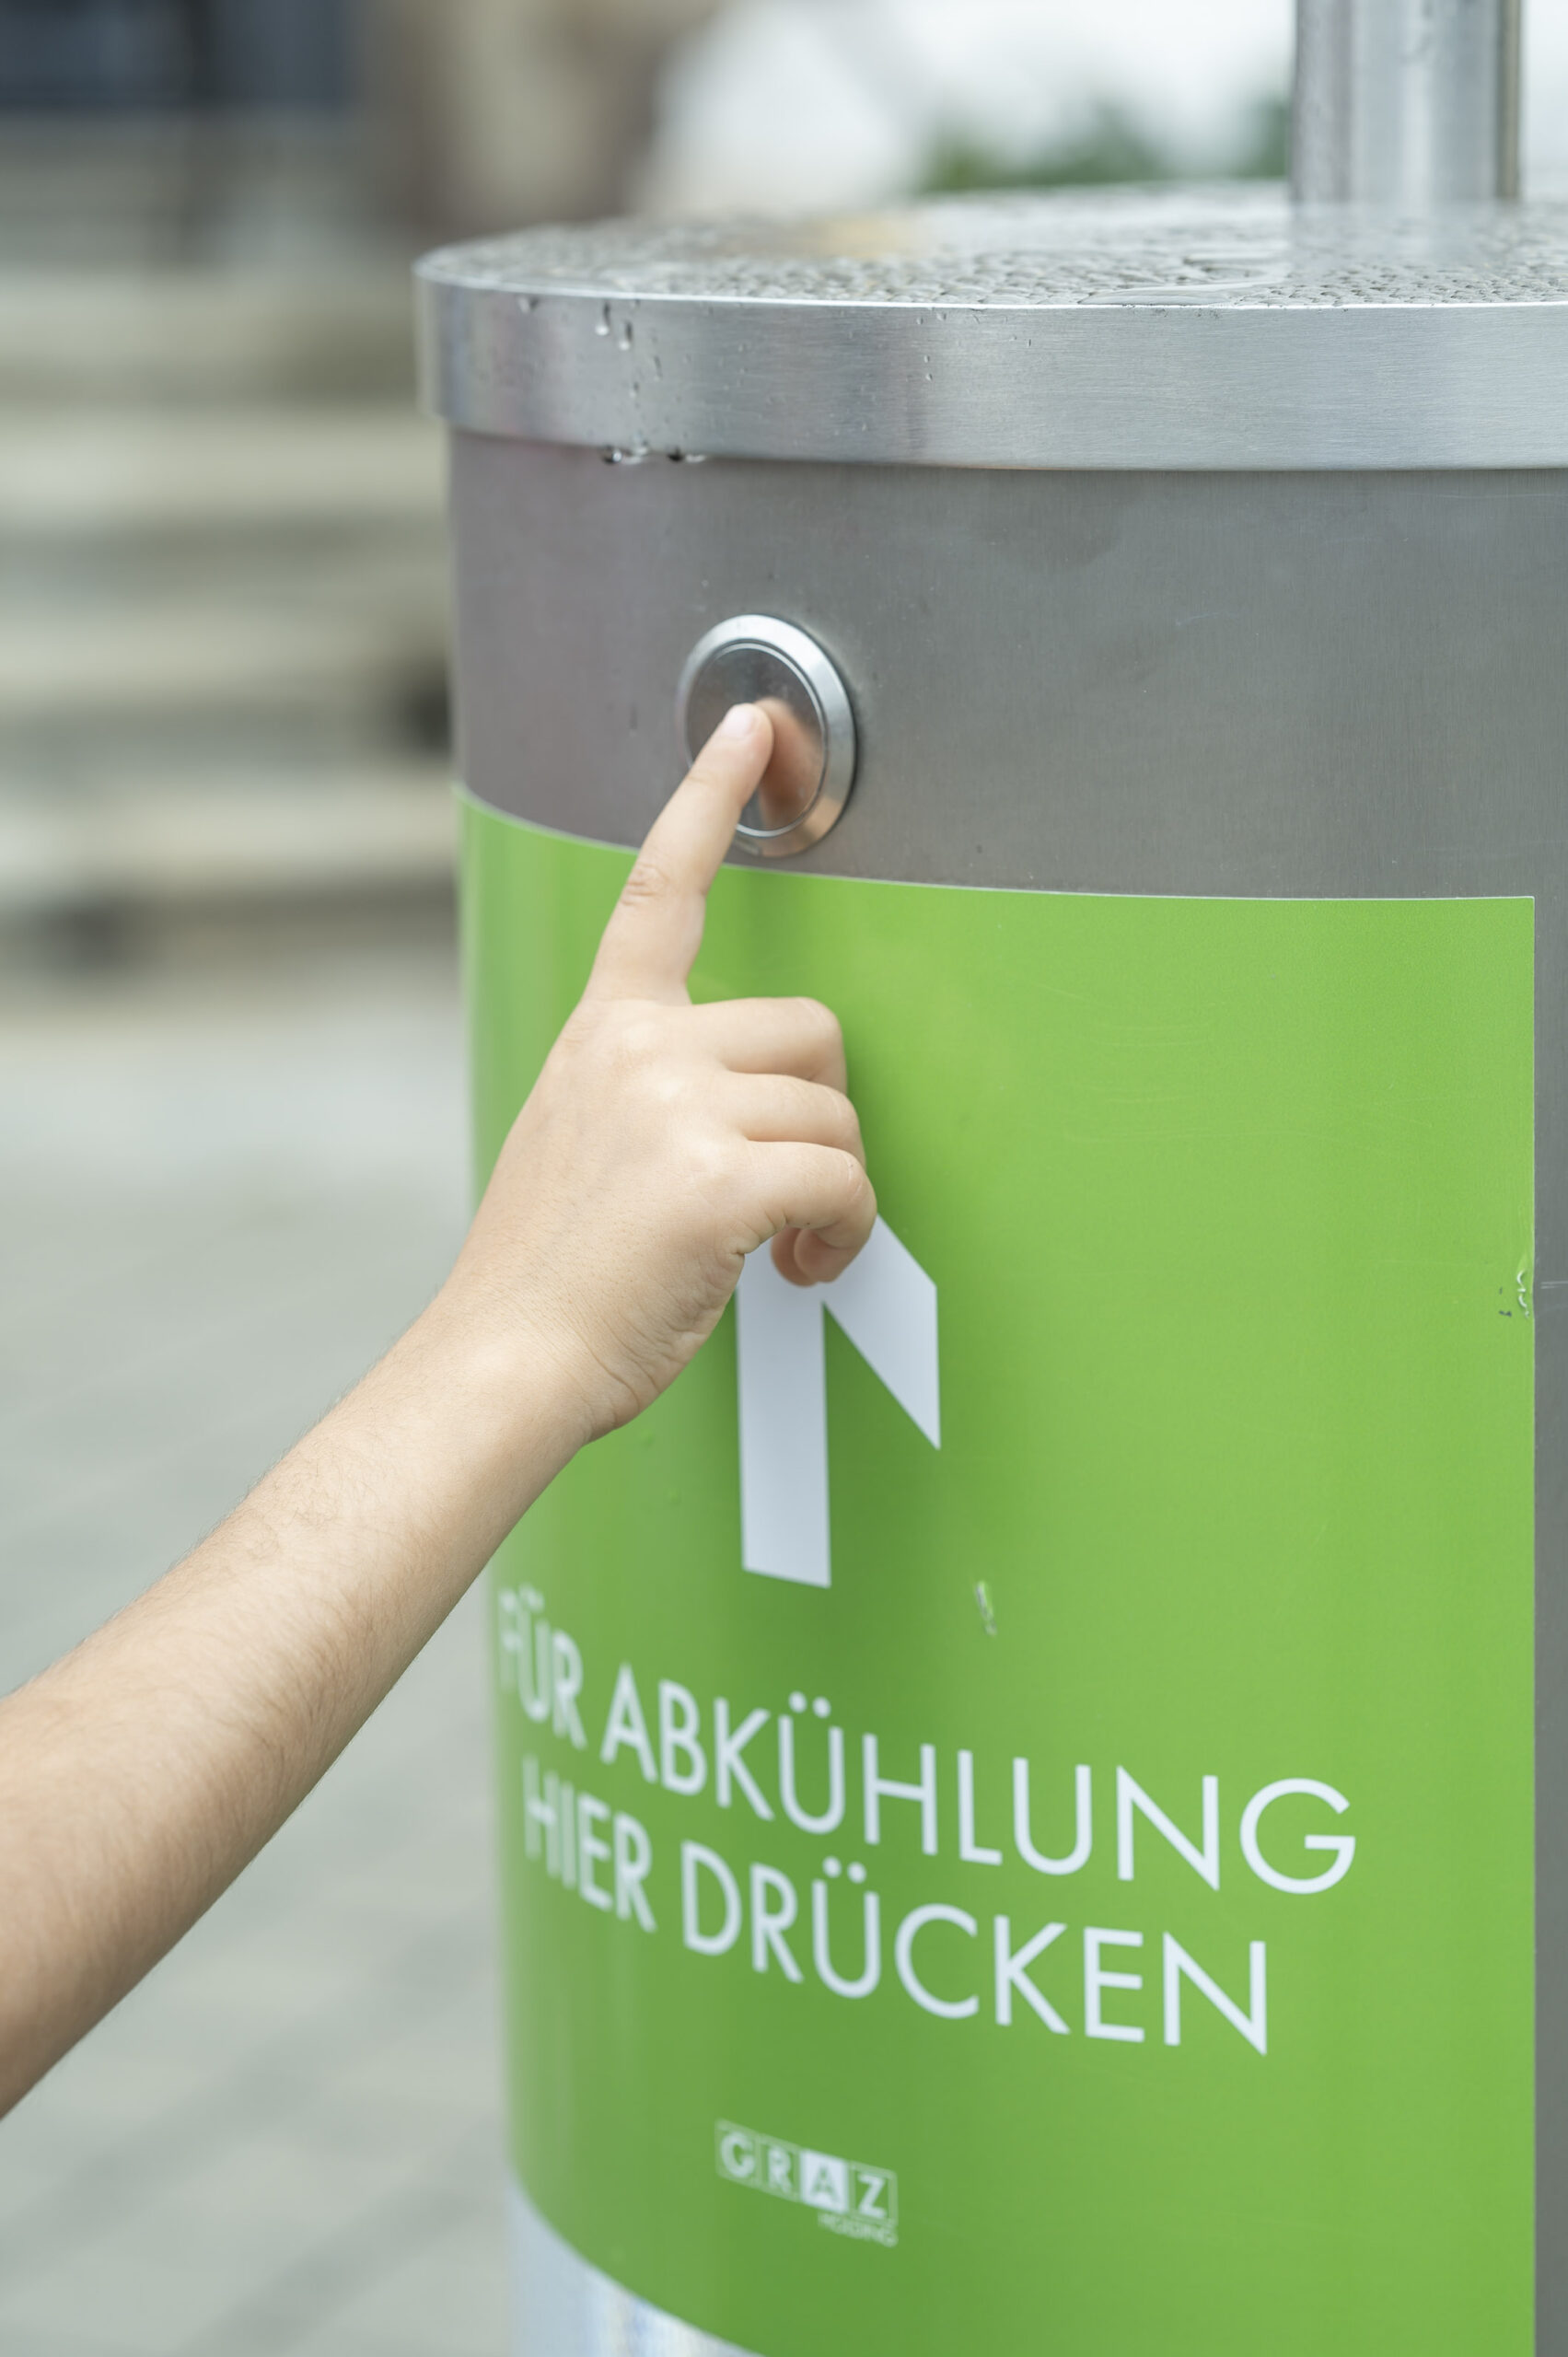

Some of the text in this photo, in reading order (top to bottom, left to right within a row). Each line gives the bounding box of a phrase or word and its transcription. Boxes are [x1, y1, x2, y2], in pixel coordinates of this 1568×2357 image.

[499, 1582, 1356, 1895] FÜR ABKÜHLUNG
[522, 1753, 1267, 2056] HIER DRÜCKEN
[720, 2130, 888, 2220] GRAZ
